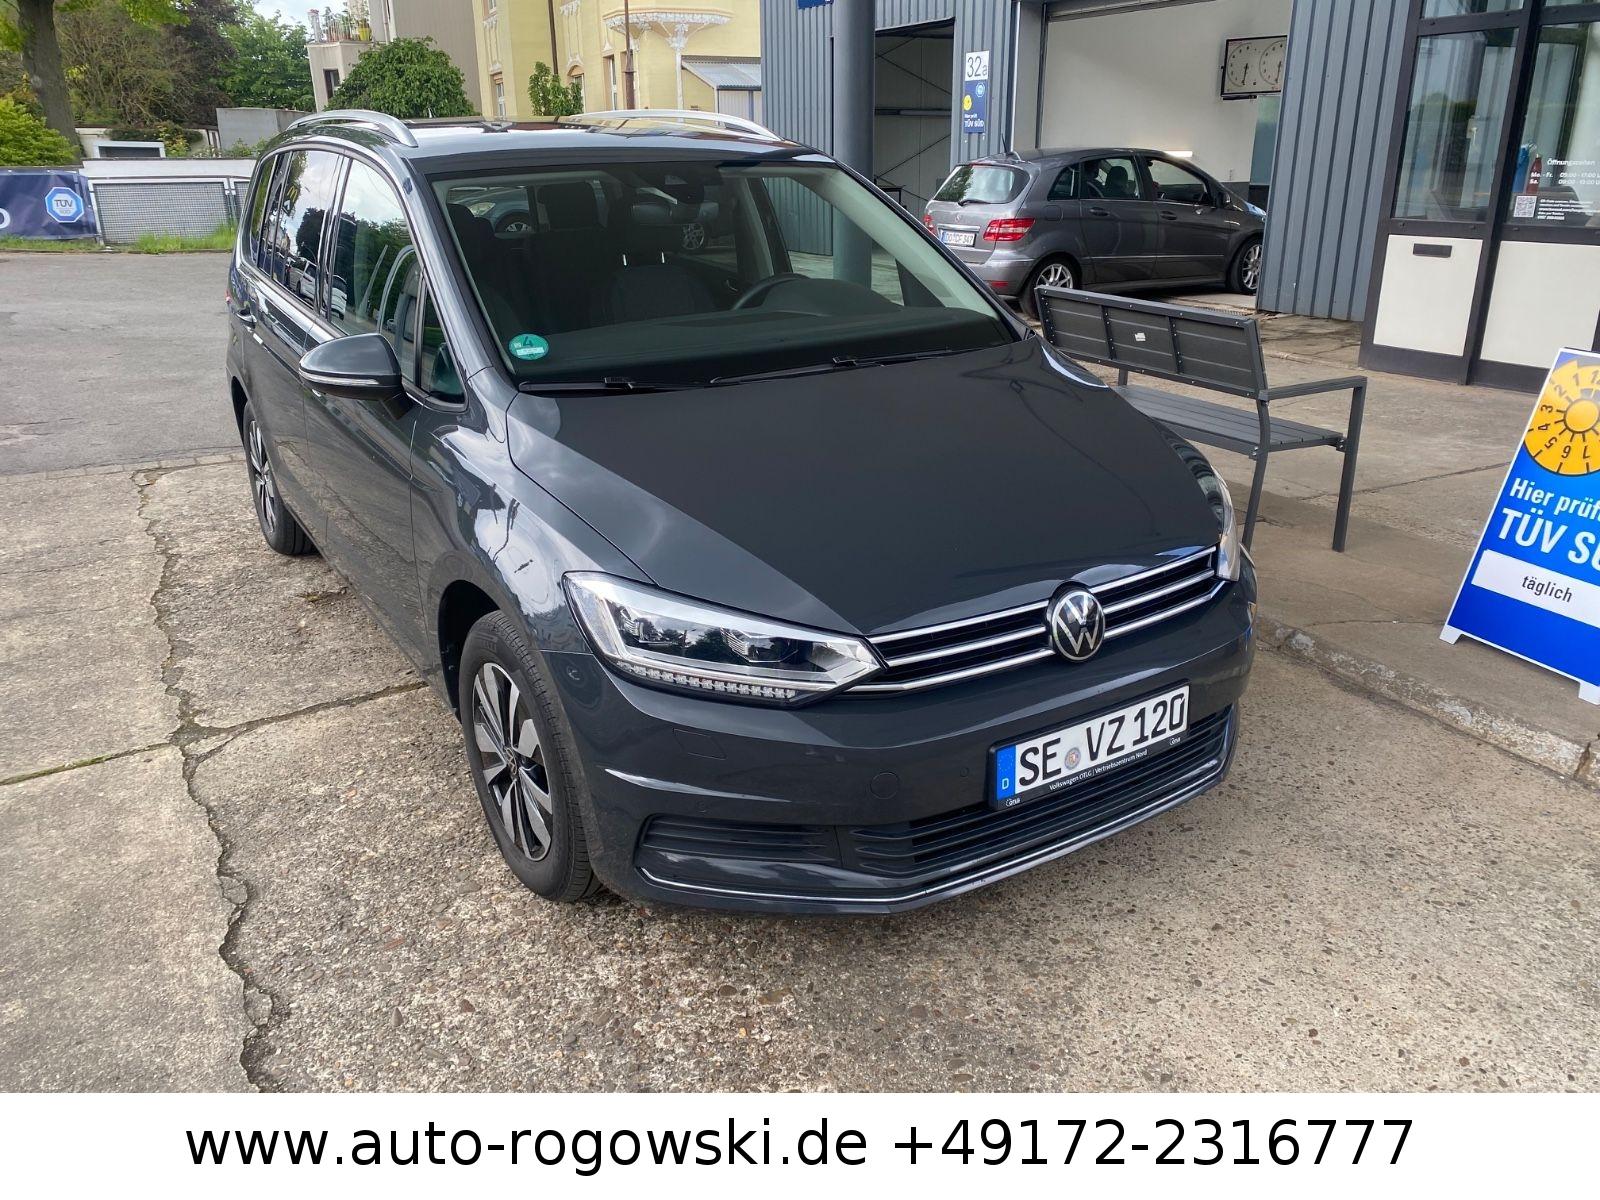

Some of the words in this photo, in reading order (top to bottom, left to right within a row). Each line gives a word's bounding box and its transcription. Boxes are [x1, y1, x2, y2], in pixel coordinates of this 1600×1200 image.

[966, 56, 988, 78] 32a
[54, 199, 73, 208] TÜV
[1572, 373, 1580, 386] 1
[1553, 384, 1567, 397] 2
[1540, 404, 1553, 413] 3
[1537, 422, 1551, 431] 4
[1544, 436, 1558, 450] 5
[1561, 445, 1571, 459] 6
[1582, 445, 1590, 459] 7
[1509, 477, 1555, 507] Hier
[1553, 496, 1600, 522] prüf
[1498, 507, 1569, 554] TÜV
[1521, 575, 1573, 603] täglich
[1019, 737, 1062, 787] SE
[1086, 714, 1126, 762] VZ
[1132, 692, 1185, 747] 120
[1048, 775, 1079, 791] Volkswagen
[1135, 748, 1149, 760] Nord
